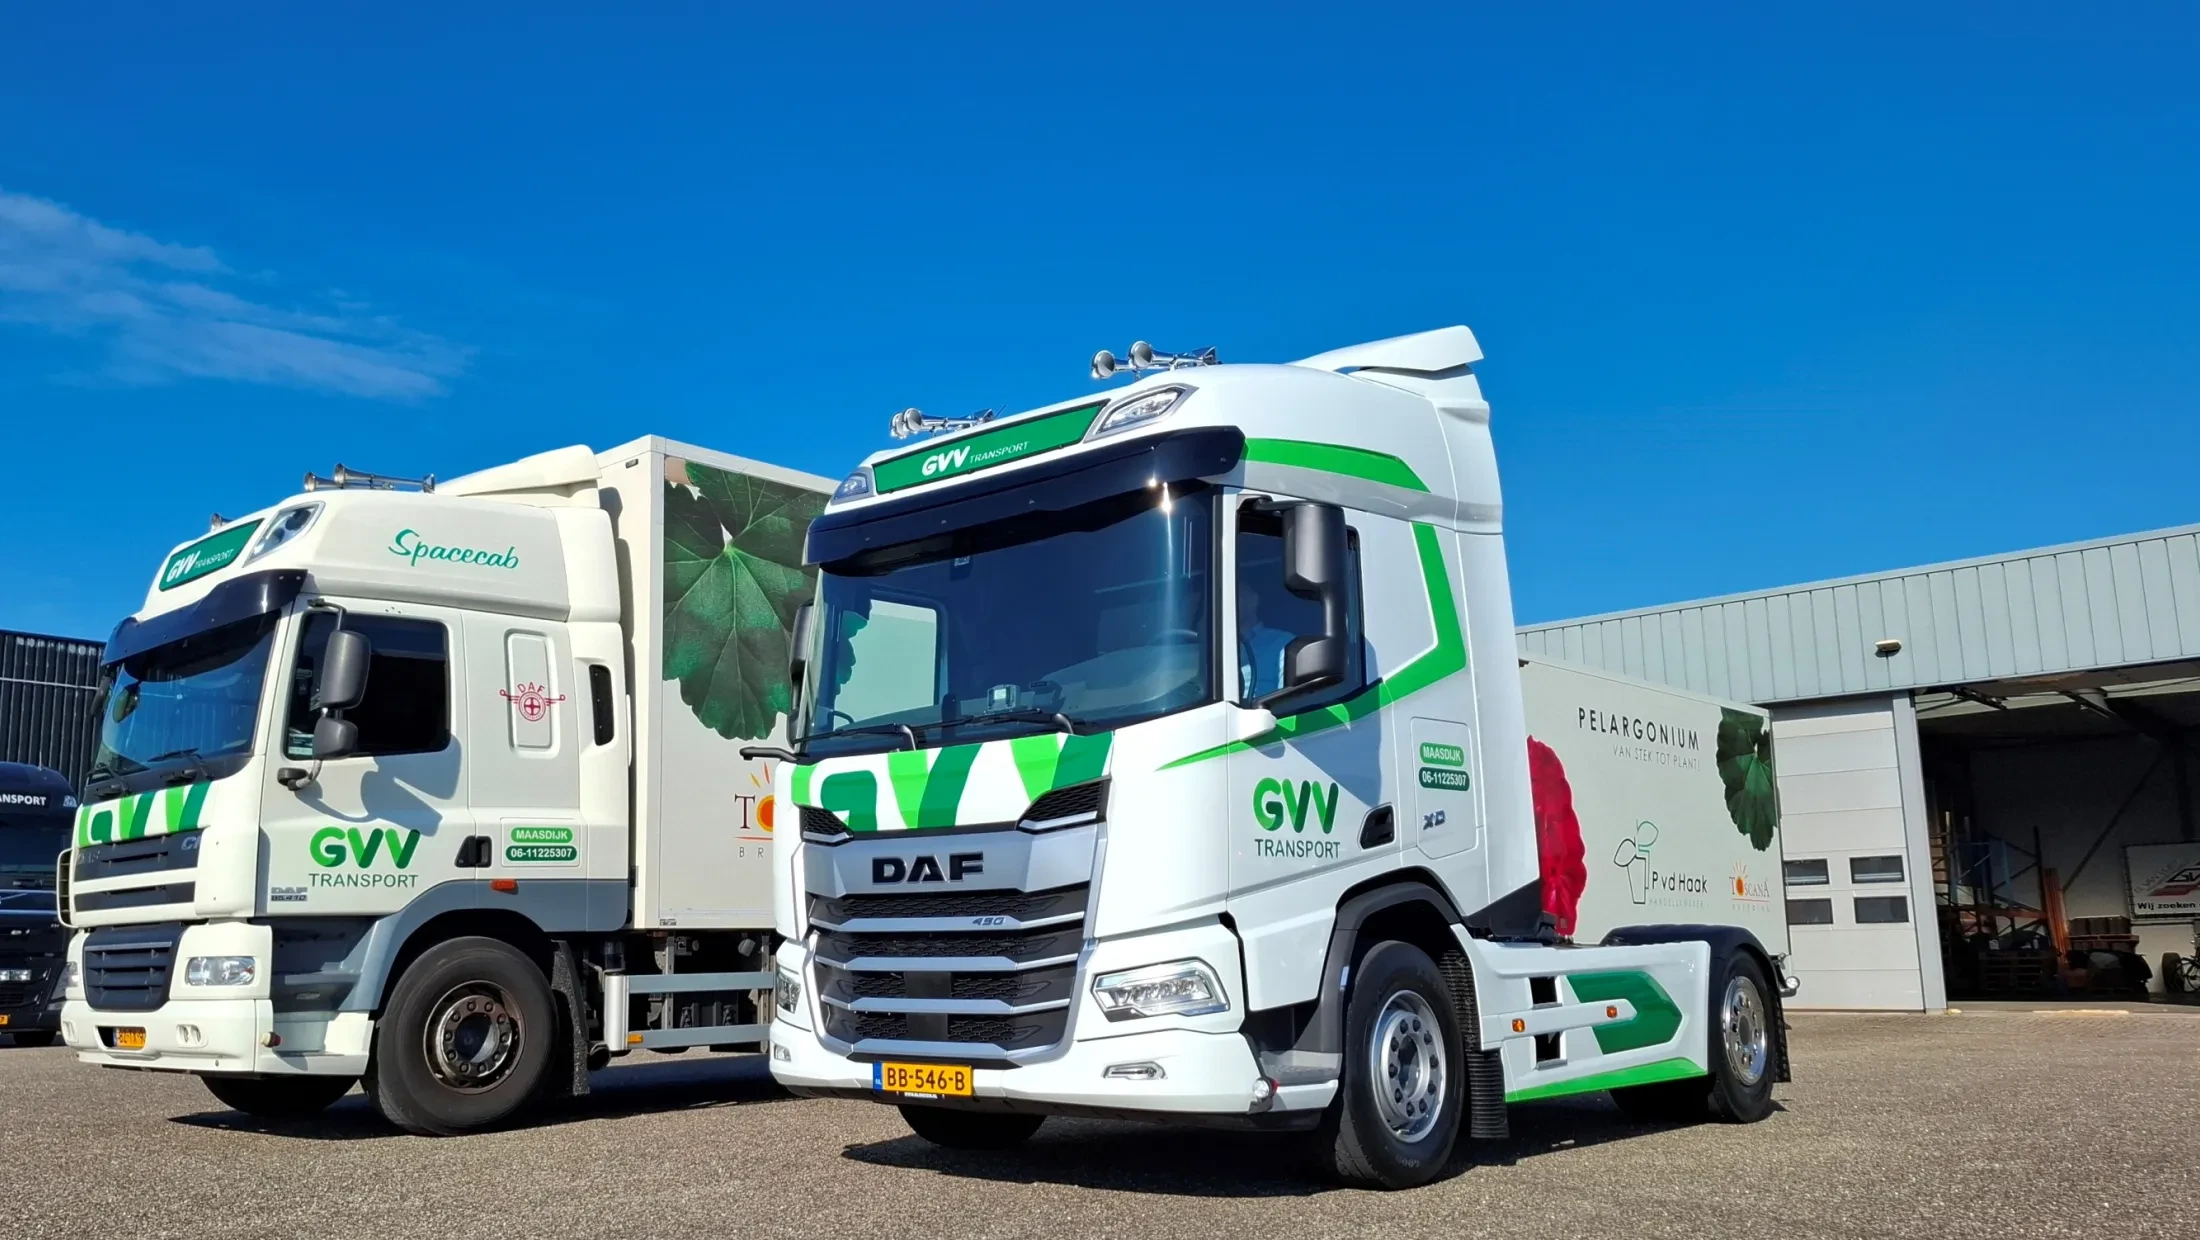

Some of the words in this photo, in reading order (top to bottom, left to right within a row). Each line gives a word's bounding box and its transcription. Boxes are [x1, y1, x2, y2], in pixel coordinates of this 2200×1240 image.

[922, 445, 971, 476] GVV
[970, 441, 1029, 464] TRANSPORT
[388, 528, 519, 569] Spacecab
[166, 550, 202, 582] GVV
[517, 682, 545, 693] DAF
[1578, 706, 1700, 751] PELARGONIUM
[1423, 745, 1461, 762] MAASDIJK
[1613, 744, 1631, 758] VAN
[1634, 747, 1652, 762] STEK
[1656, 751, 1670, 765] TOT
[1422, 770, 1466, 787] 06-11225307
[1253, 777, 1339, 834] GVV
[1422, 809, 1446, 831] XD
[516, 829, 568, 840] MAASDIJK
[309, 826, 421, 869] GVV
[510, 848, 573, 858] 06-11225307
[1254, 839, 1341, 859] TRANSPORT
[872, 852, 984, 884] DAF
[309, 873, 418, 888] TRANSPORT
[2137, 902, 2154, 911] Wij
[2157, 901, 2196, 910] zoeken
[887, 1067, 965, 1091] BB-546-B
